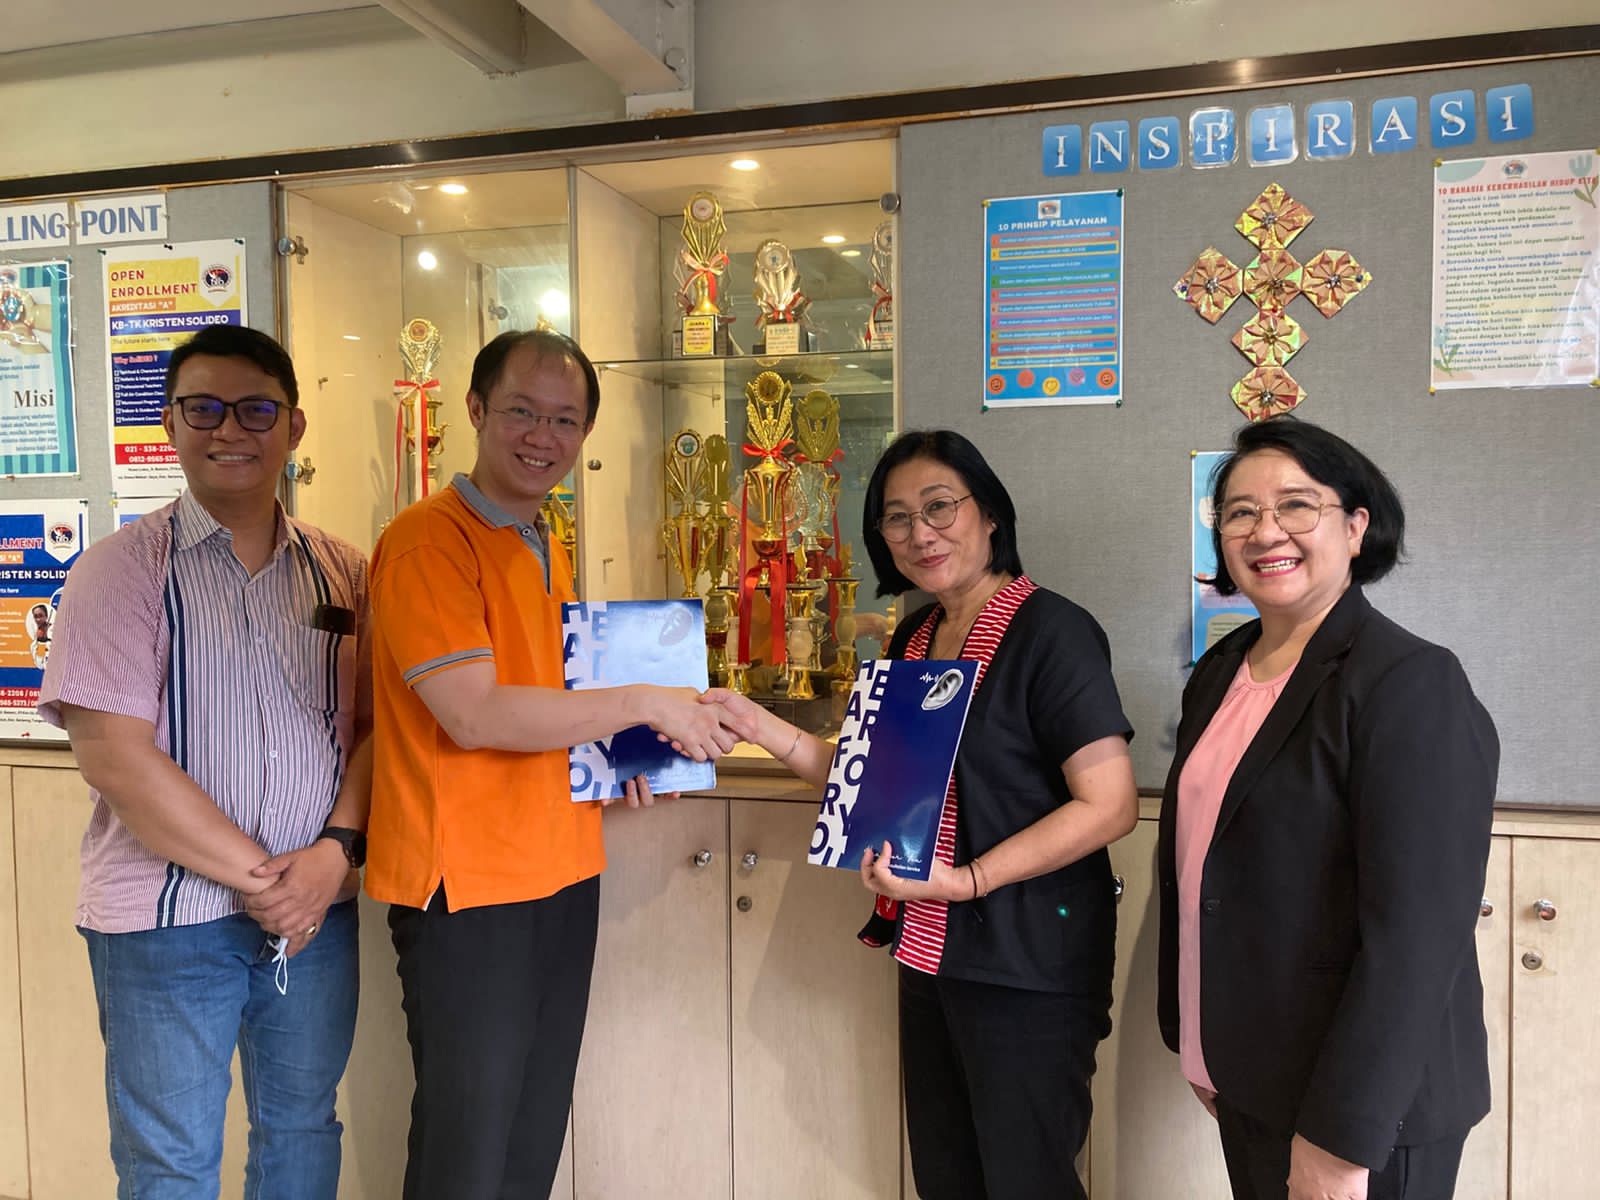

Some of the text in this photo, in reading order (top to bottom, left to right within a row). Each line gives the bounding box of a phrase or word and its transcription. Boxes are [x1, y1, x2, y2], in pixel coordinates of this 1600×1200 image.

[1055, 96, 1518, 168] INSPIRASI
[0, 204, 161, 242] LING POINT
[1011, 221, 1048, 230] PRINSIP
[1050, 216, 1108, 228] PELAYANAN
[111, 270, 144, 281] OPEN
[111, 283, 198, 298] ENROLLMENT
[112, 302, 156, 312] AKREDITASI
[112, 315, 229, 330] KB-TK KRISTEN SOLIDEO
[13, 389, 55, 408] Misi
